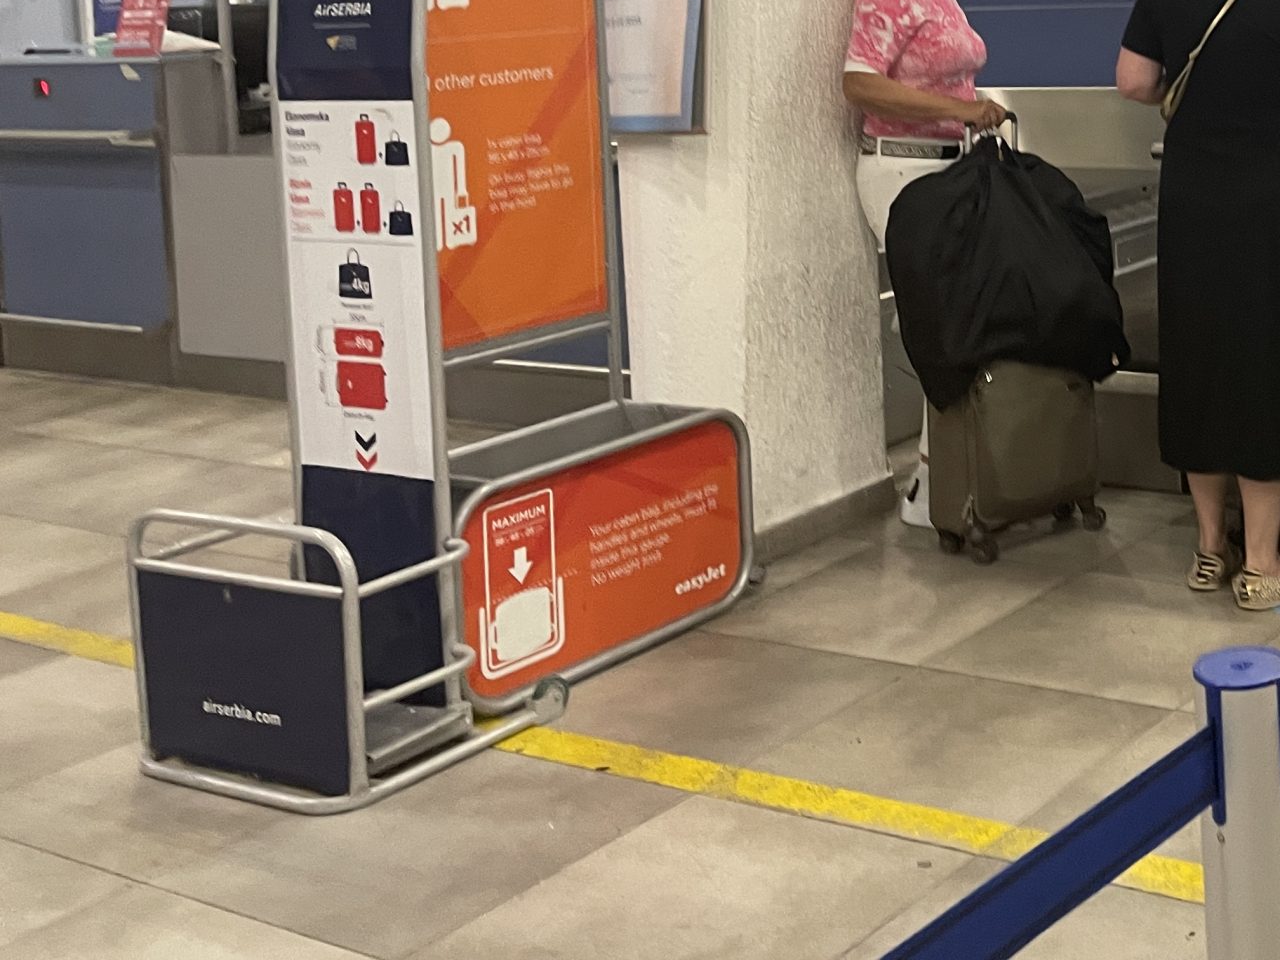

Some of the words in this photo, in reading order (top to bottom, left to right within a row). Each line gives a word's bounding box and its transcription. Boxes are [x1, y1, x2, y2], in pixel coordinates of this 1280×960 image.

[314, 2, 372, 17] AirSERBIA
[435, 70, 475, 91] other
[479, 66, 554, 88] customers
[452, 216, 471, 236] x1
[491, 504, 546, 531] MAXIMUM
[675, 563, 727, 596] easyJet
[202, 696, 282, 727] airserbia.com
